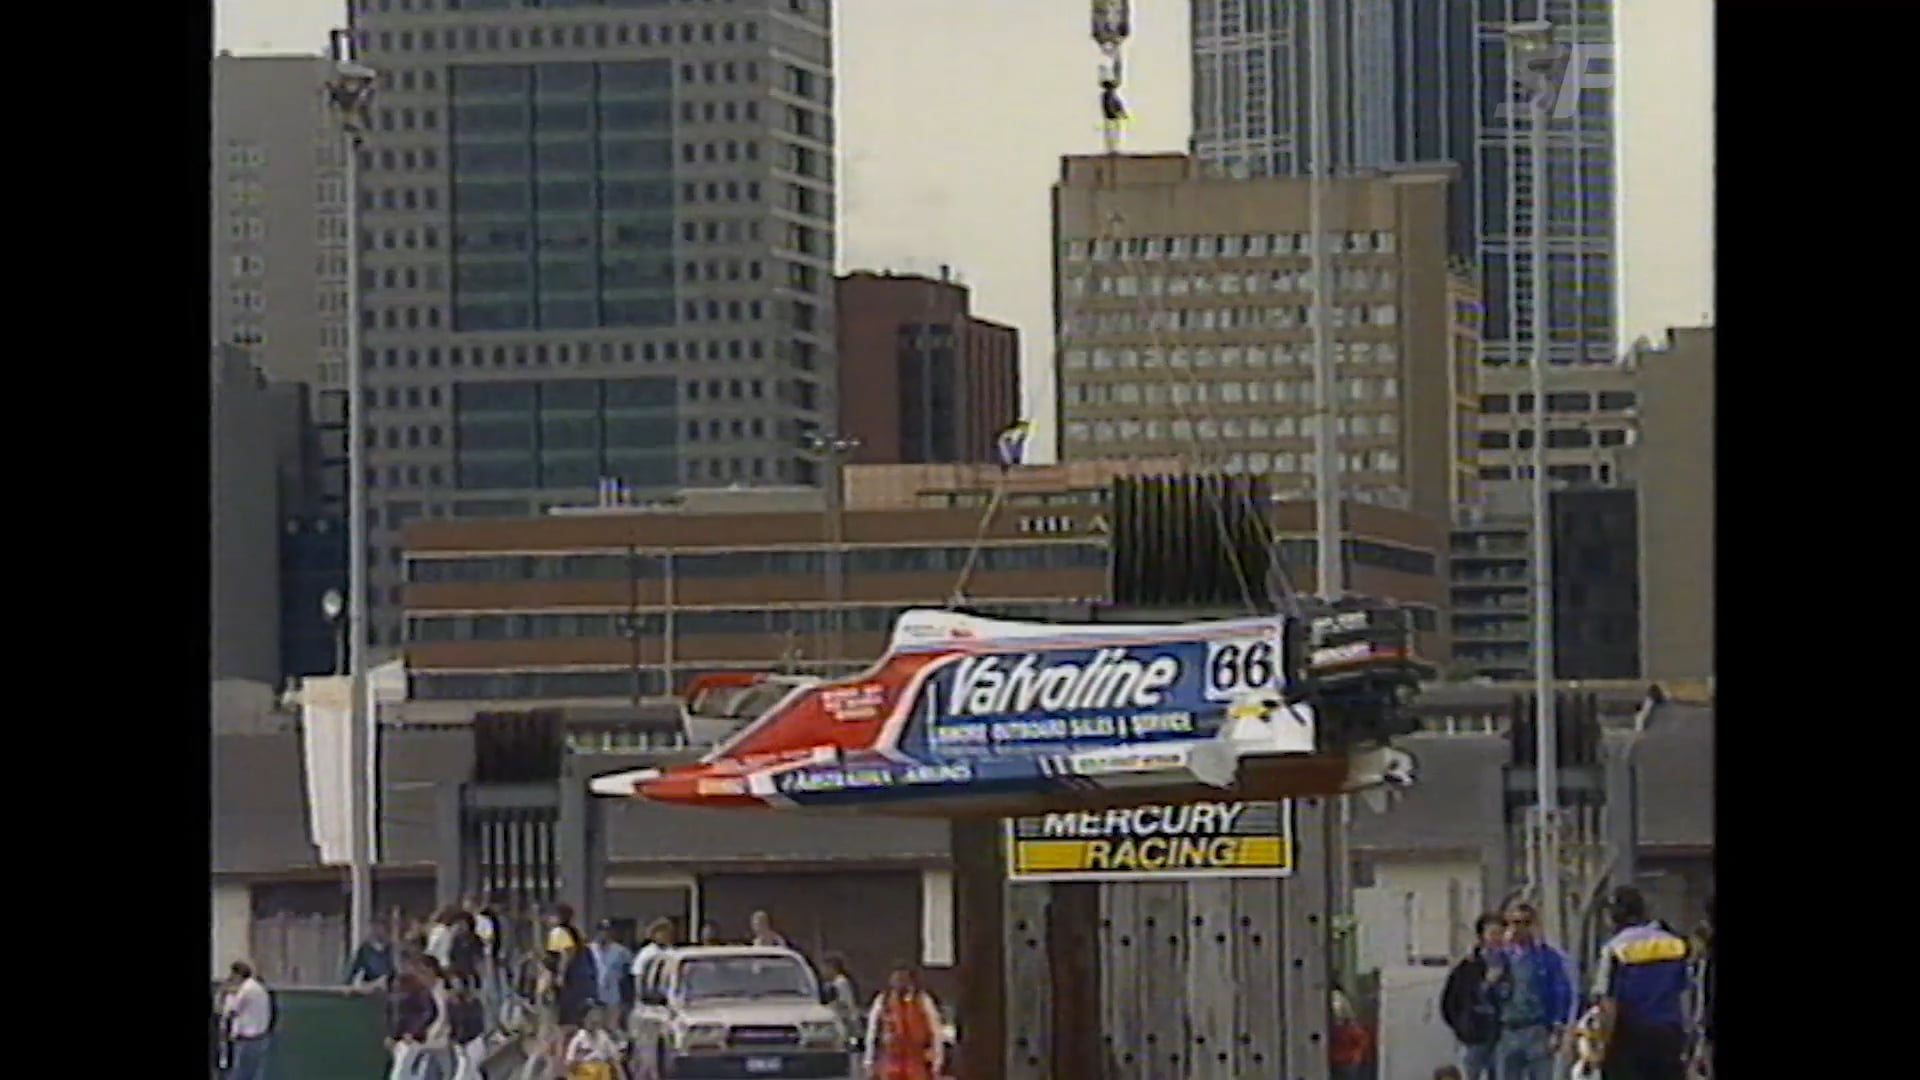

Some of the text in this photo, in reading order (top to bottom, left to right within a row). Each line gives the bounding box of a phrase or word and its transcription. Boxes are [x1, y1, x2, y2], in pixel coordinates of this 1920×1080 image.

[950, 648, 1179, 716] Valvoline
[1213, 642, 1271, 690] 66
[1043, 802, 1242, 837] MERCURY
[1086, 837, 1239, 869] RACING
